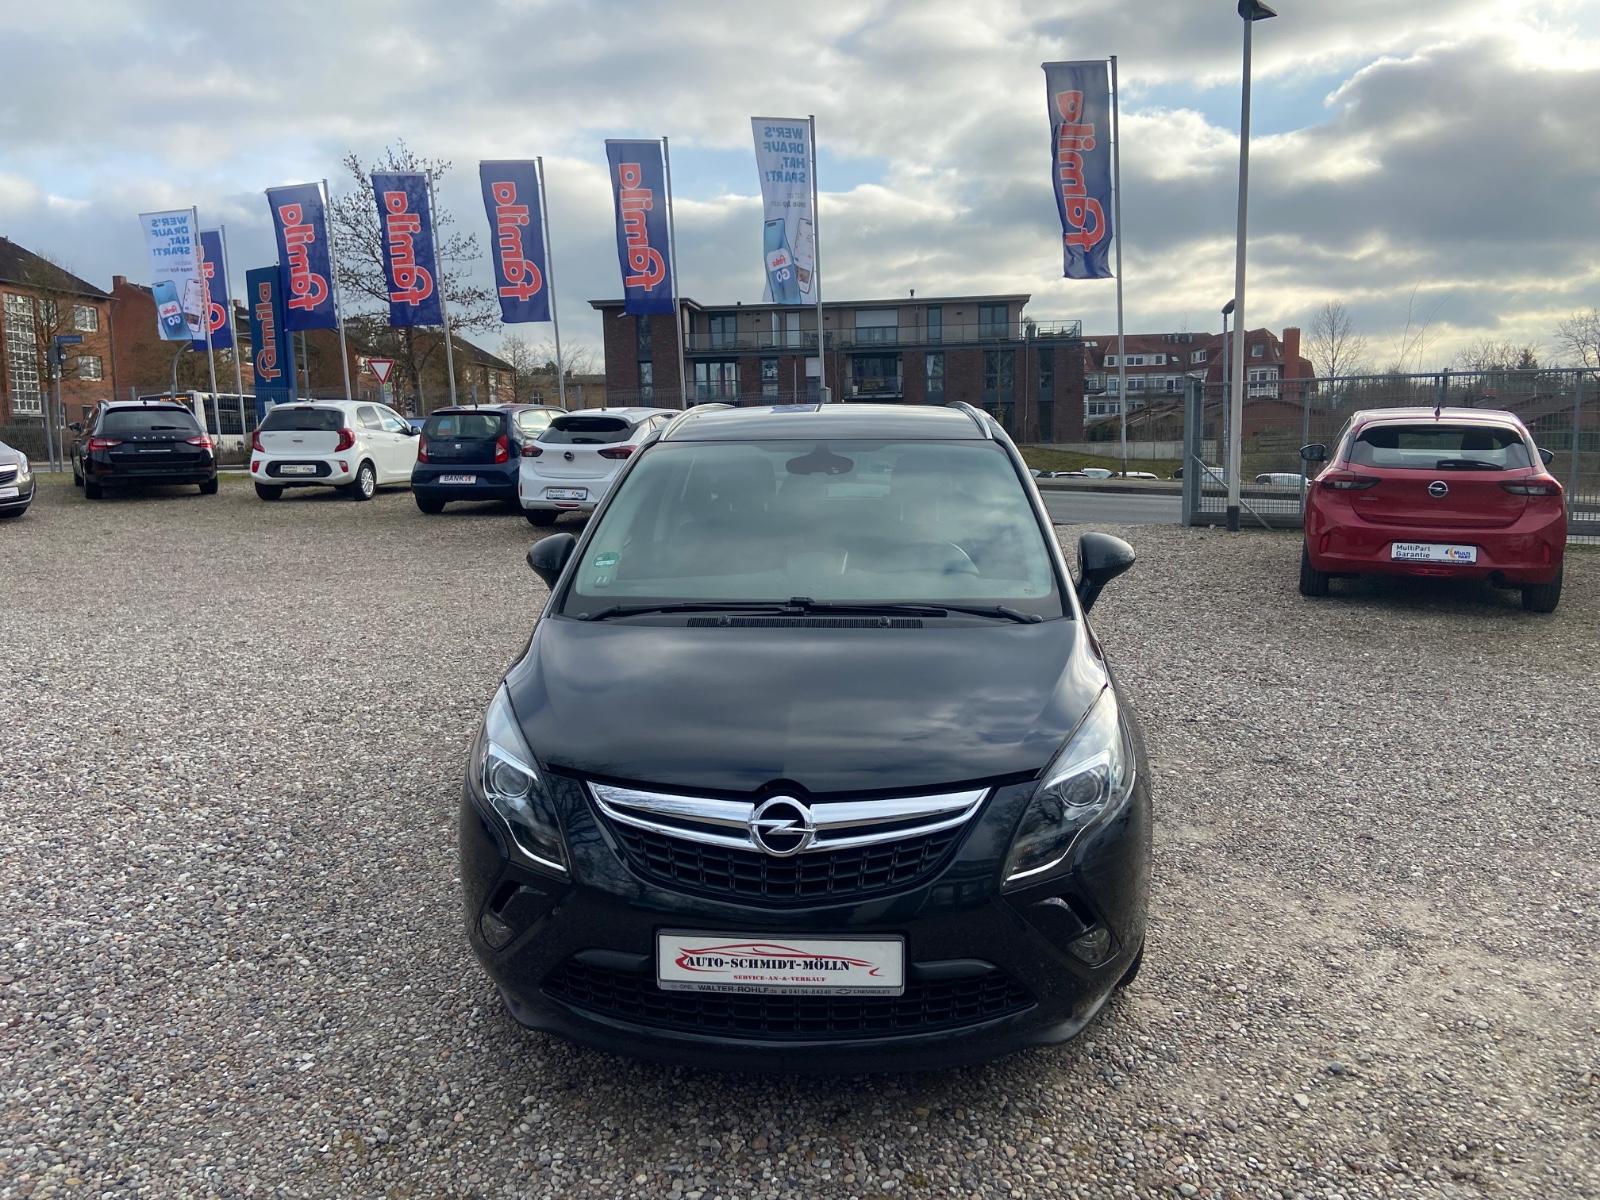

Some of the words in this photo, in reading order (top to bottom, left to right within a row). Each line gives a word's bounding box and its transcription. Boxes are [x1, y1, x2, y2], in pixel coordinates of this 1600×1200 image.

[255, 281, 281, 382] famila
[1396, 544, 1431, 552] MultiPart
[1396, 550, 1431, 558] Garantie
[686, 955, 851, 972] AUTO-SCHMIDT-MÖLLN
